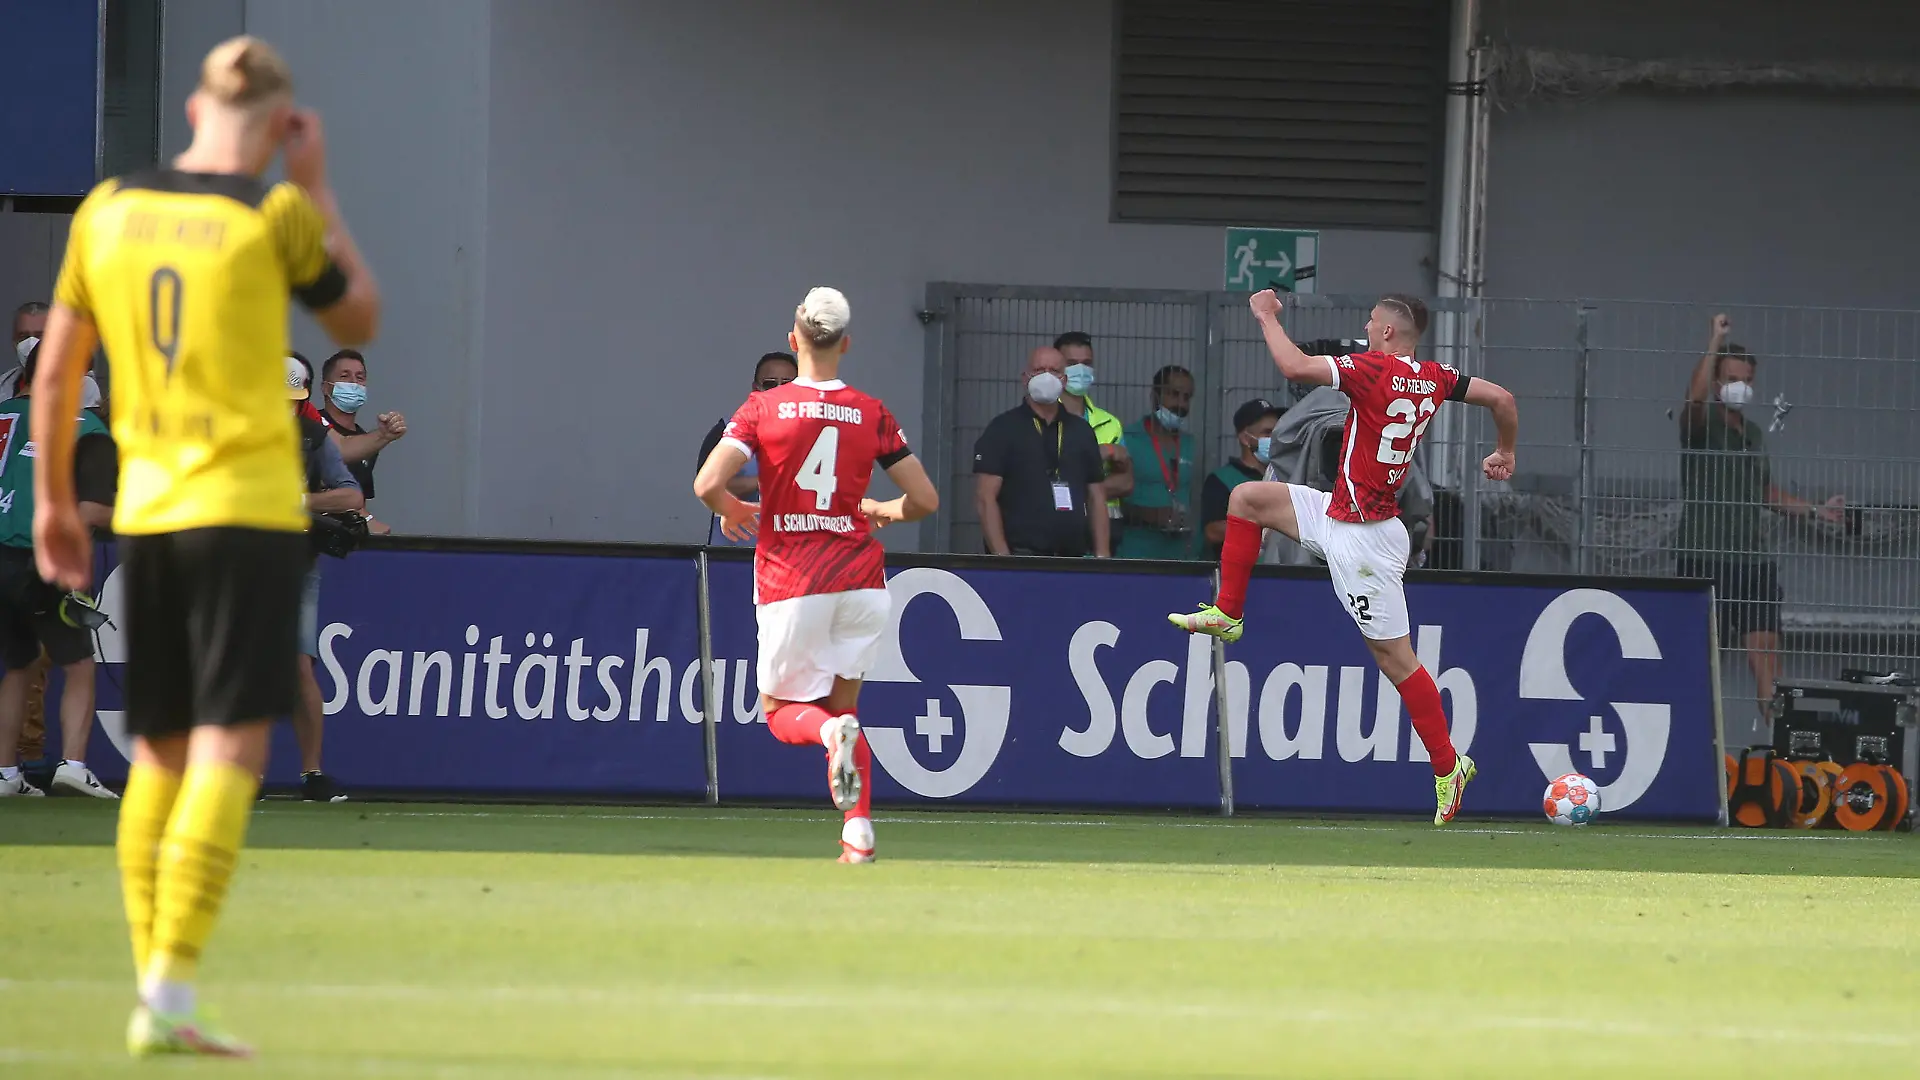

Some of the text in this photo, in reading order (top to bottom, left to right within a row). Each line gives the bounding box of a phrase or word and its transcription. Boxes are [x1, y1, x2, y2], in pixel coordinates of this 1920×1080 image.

[1391, 376, 1406, 392] SC
[778, 402, 862, 425] SC FREIBURG
[794, 426, 838, 510] 4
[773, 513, 855, 533] N. SCHLOTTERBECK
[318, 622, 766, 724] Sanitätshau
[1058, 620, 1478, 763] Schaub
